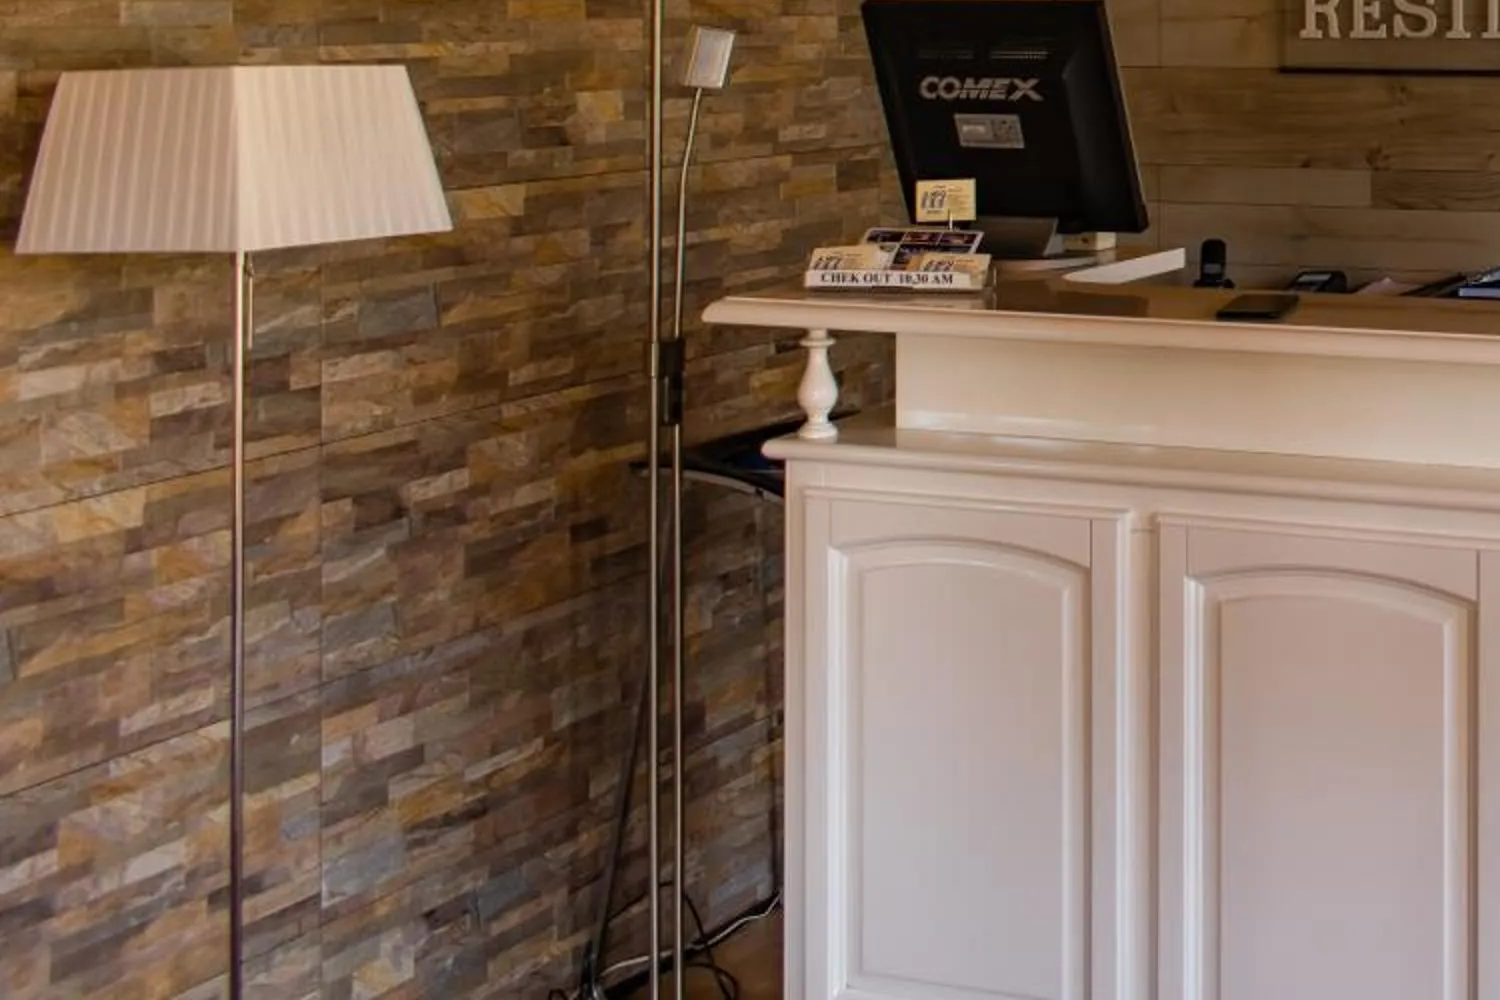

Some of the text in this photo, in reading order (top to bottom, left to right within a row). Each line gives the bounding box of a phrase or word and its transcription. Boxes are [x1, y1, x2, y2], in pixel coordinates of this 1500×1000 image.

[919, 76, 1044, 101] COMEX
[821, 271, 860, 284] CHEK
[863, 271, 892, 285] OUT
[931, 273, 953, 285] AM
